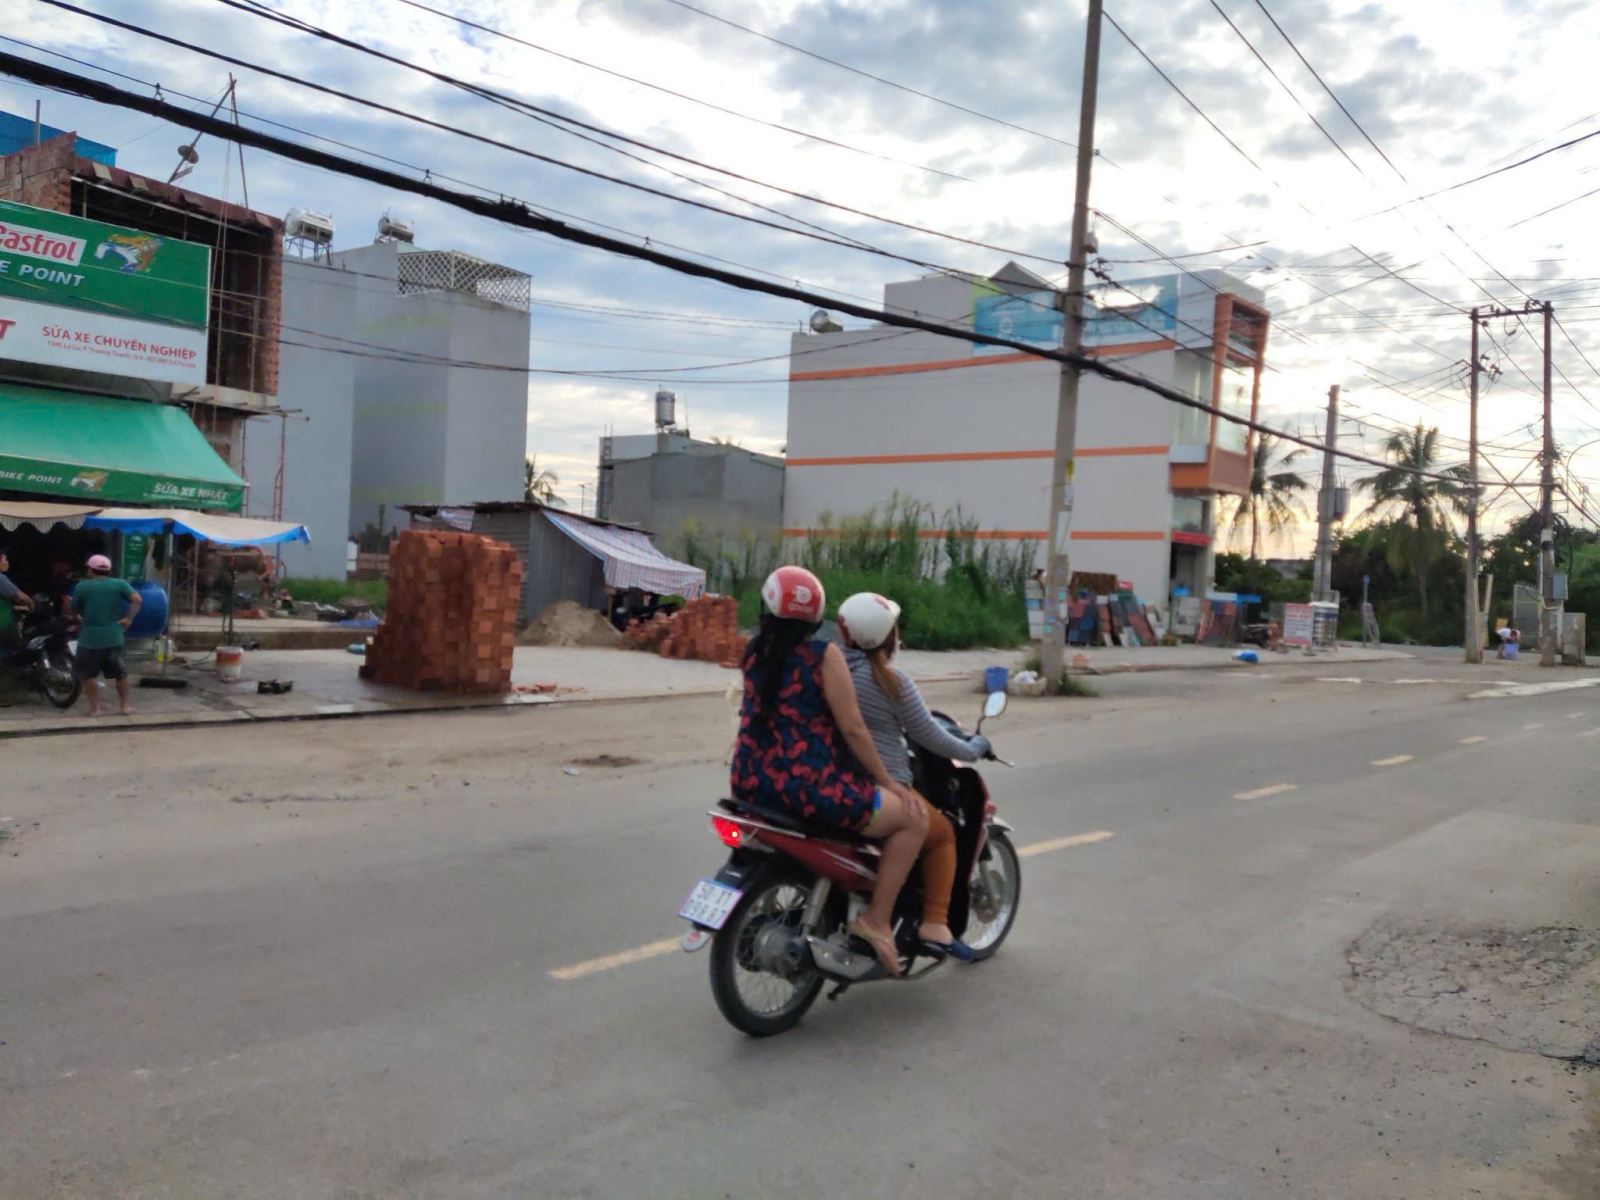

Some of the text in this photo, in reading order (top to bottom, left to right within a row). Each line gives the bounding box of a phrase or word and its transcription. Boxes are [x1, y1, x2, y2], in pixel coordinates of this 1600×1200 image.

[19, 264, 85, 286] POINT
[42, 324, 70, 339] SỬA
[75, 331, 91, 343] XE
[94, 335, 147, 353] CHUYÊN
[28, 473, 63, 485] POINT
